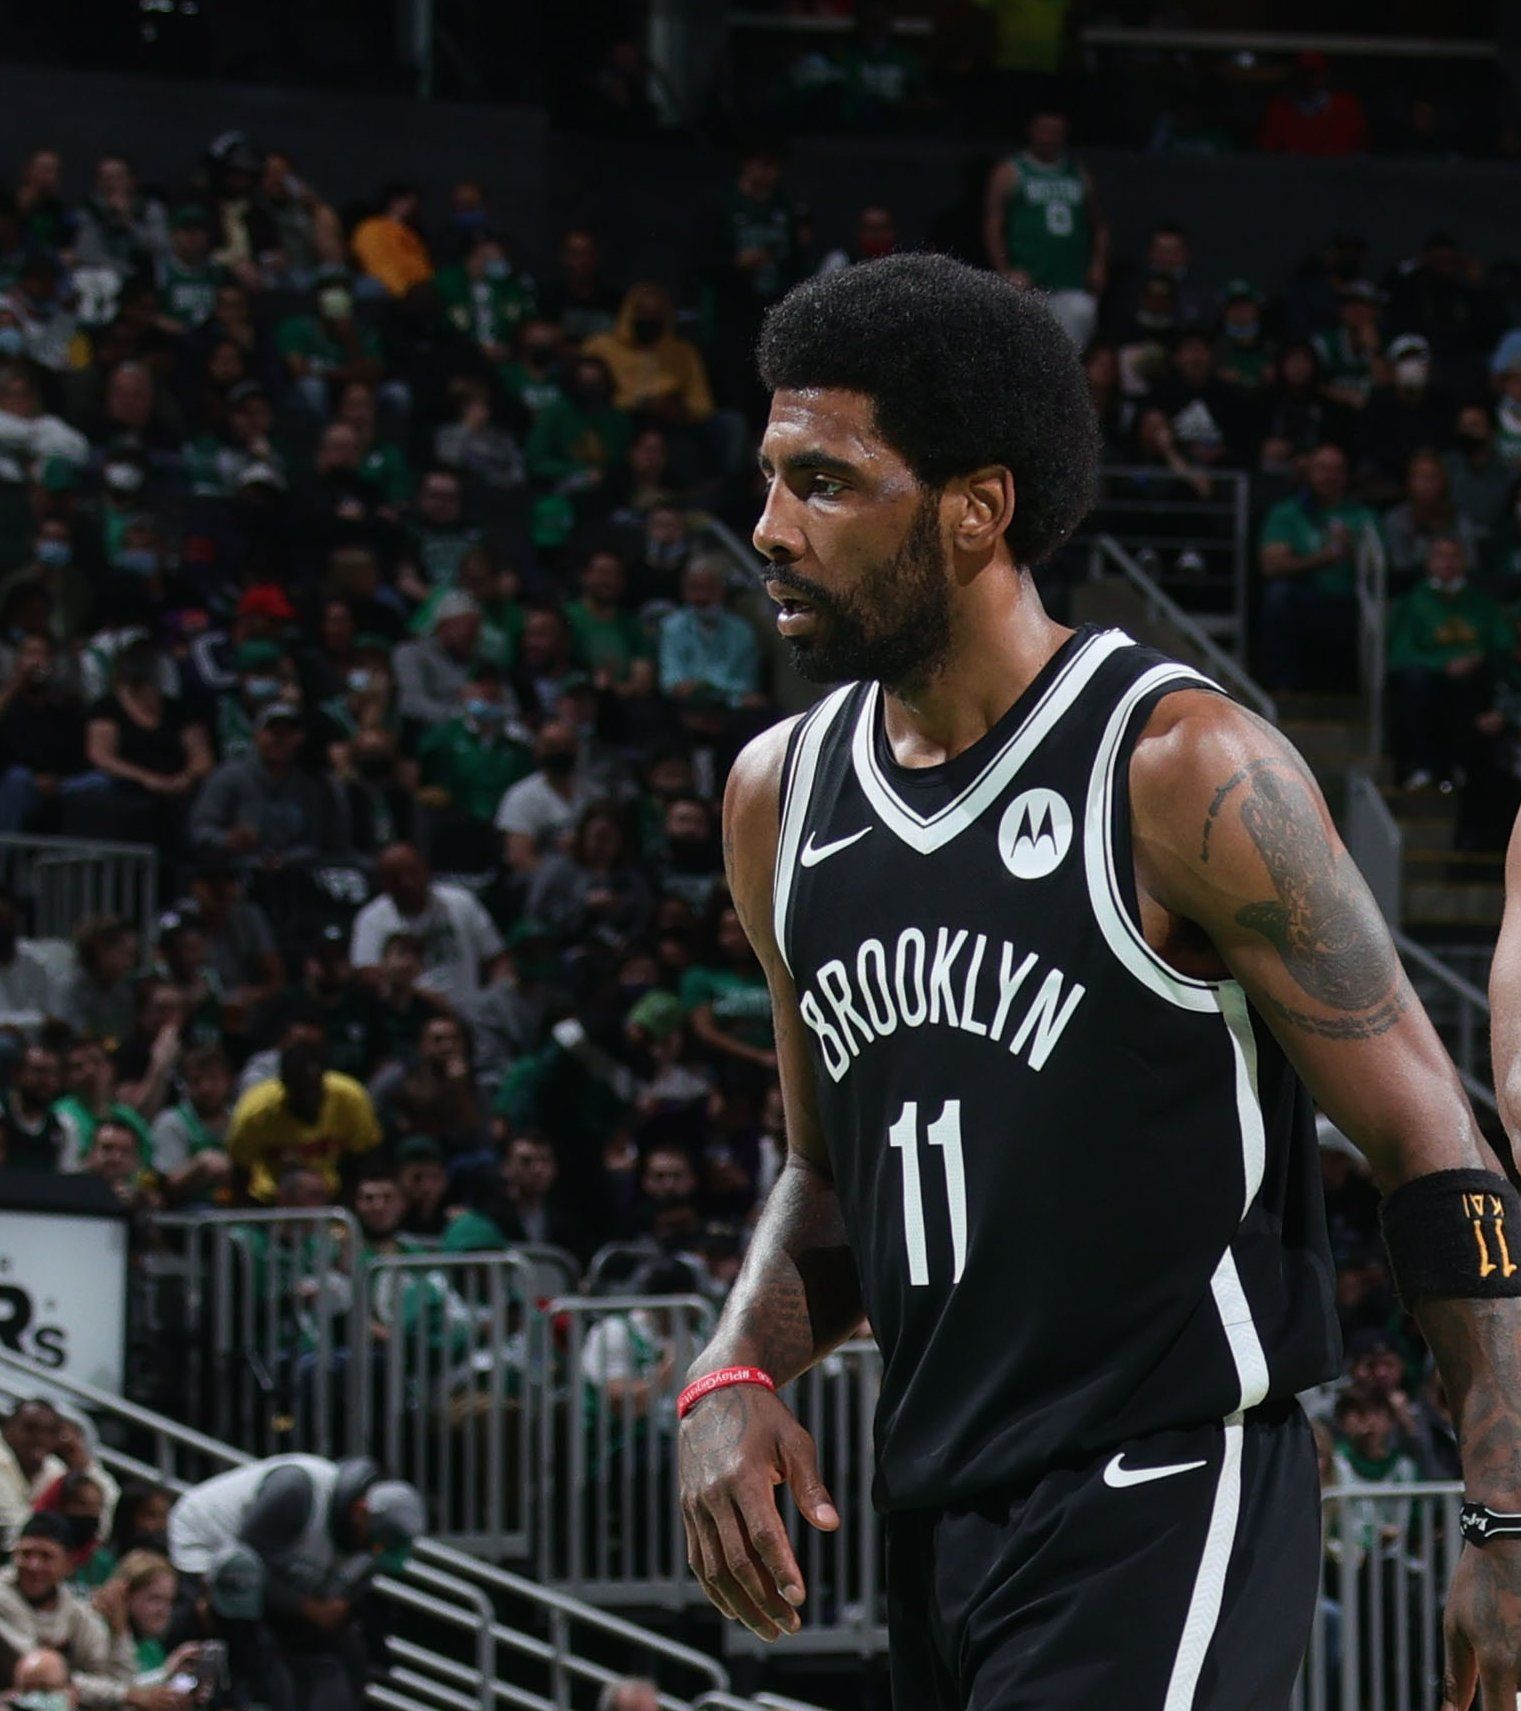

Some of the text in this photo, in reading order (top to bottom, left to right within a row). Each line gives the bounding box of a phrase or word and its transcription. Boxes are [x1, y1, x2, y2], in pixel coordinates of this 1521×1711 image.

[800, 926, 1087, 1084] BROOKLYN
[889, 1099, 968, 1286] 11
[1462, 1192, 1505, 1218] KAI
[1472, 1218, 1519, 1278] 11
